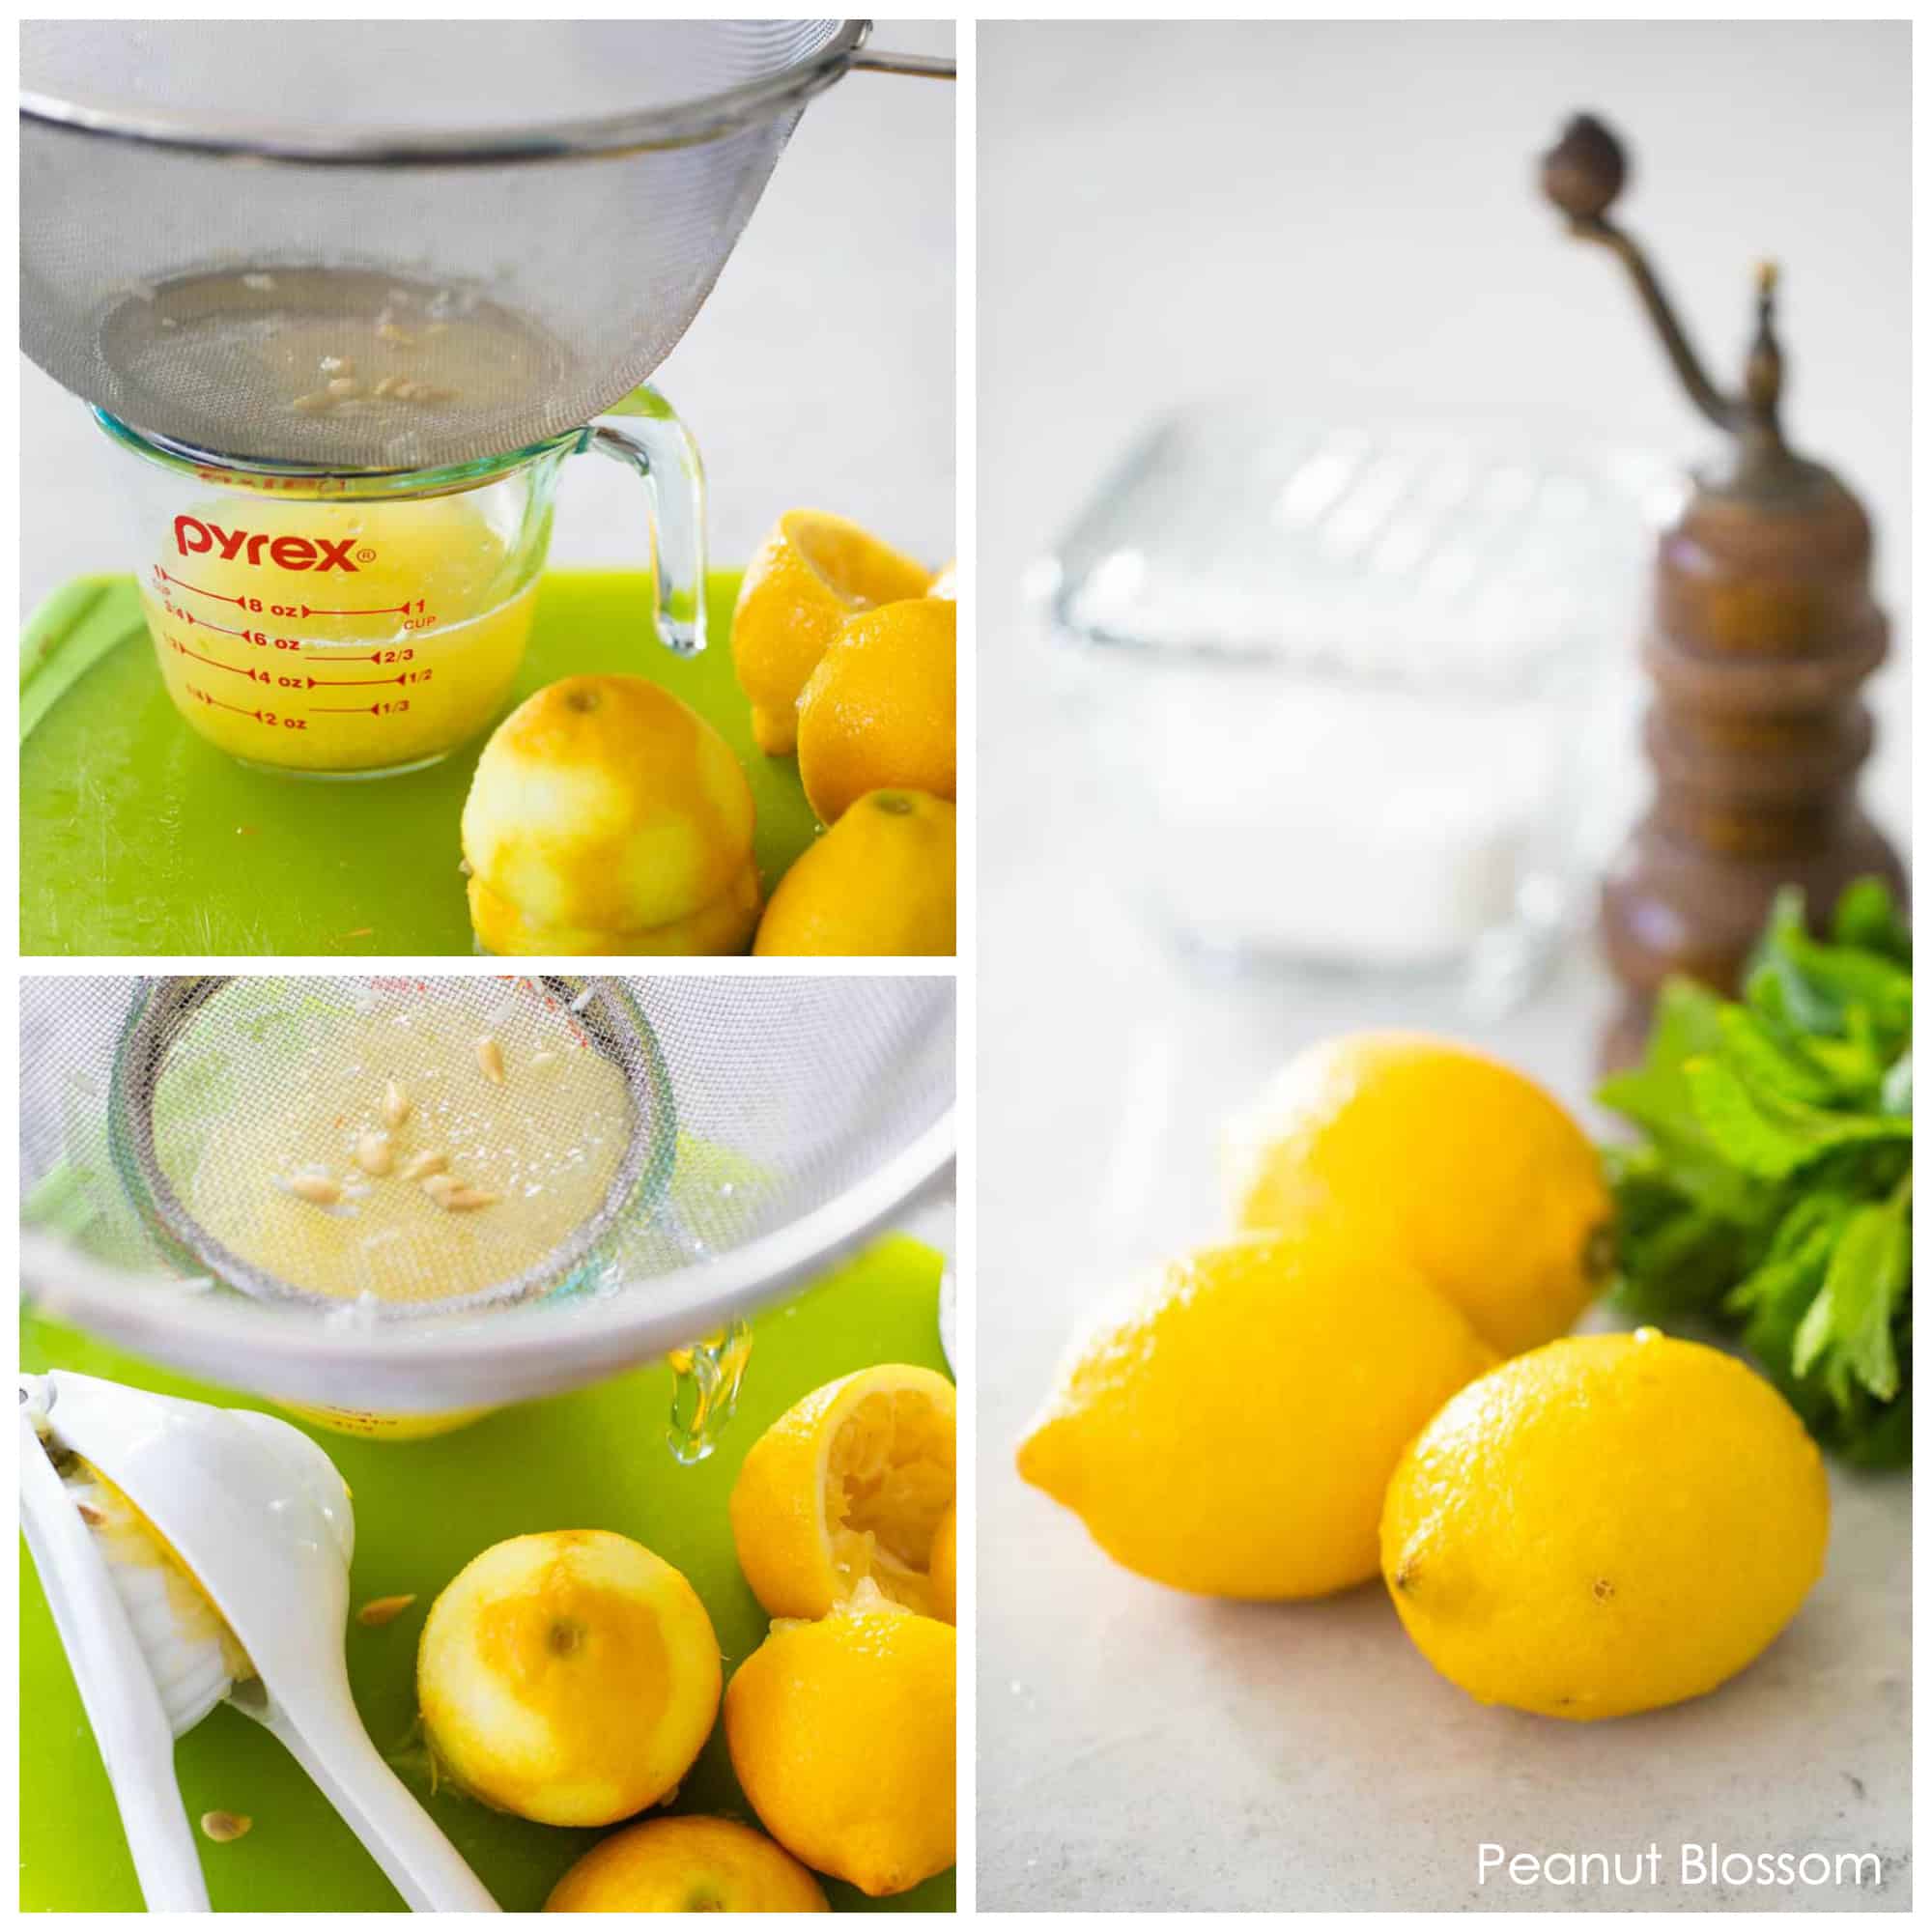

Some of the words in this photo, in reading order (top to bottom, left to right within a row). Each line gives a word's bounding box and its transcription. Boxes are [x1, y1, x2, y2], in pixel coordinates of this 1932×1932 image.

[248, 598, 263, 612] 8
[270, 605, 298, 617] oz
[415, 599, 425, 613] 1
[403, 616, 436, 630] CUP
[254, 633, 267, 646] 6
[274, 639, 299, 650] oz
[384, 649, 413, 663] 2/3
[258, 671, 271, 684] 4
[278, 677, 302, 688] oz
[410, 668, 433, 684] 1/2
[384, 699, 410, 715] 1/3
[265, 712, 277, 725] 2
[284, 718, 307, 729] oz
